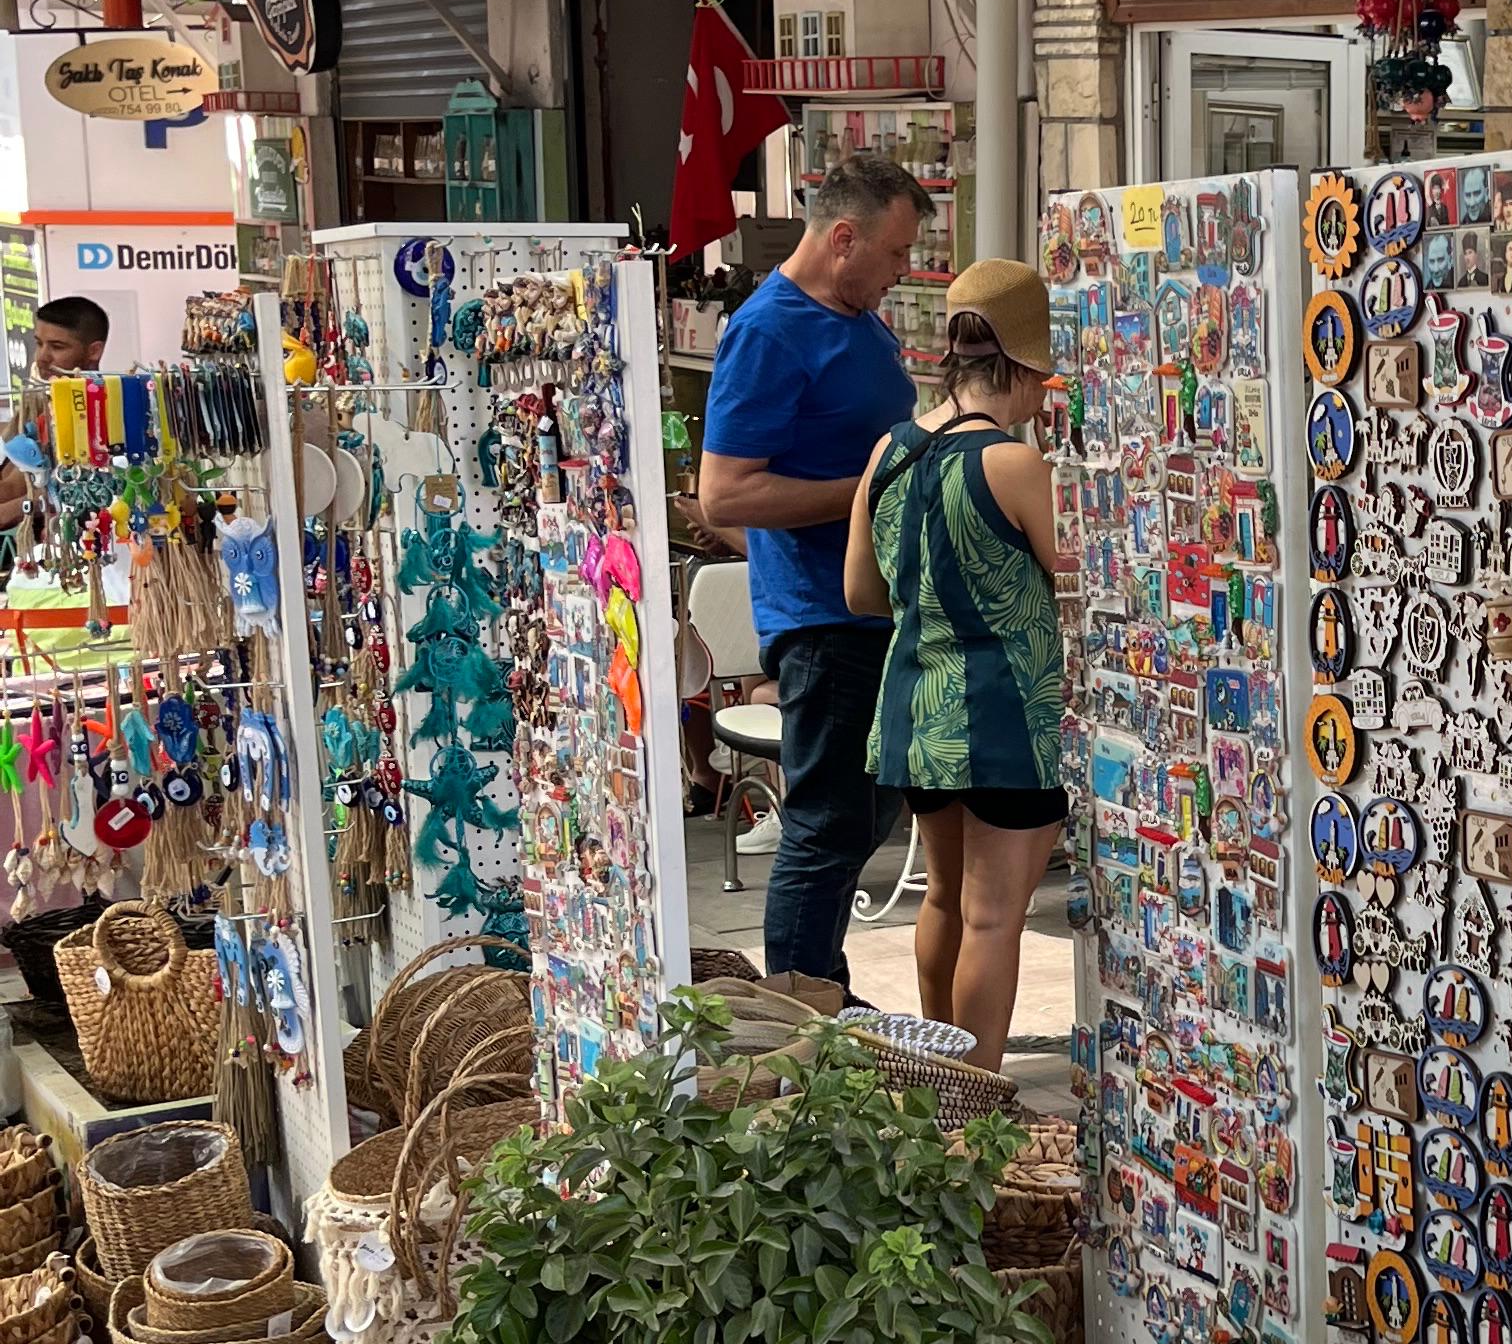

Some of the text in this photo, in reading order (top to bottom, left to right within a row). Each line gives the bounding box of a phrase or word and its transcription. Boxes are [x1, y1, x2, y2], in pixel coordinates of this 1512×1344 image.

[109, 58, 145, 85] Taş
[151, 57, 203, 83] Konak
[108, 84, 166, 103] OTEL
[1130, 202, 1145, 225] 20
